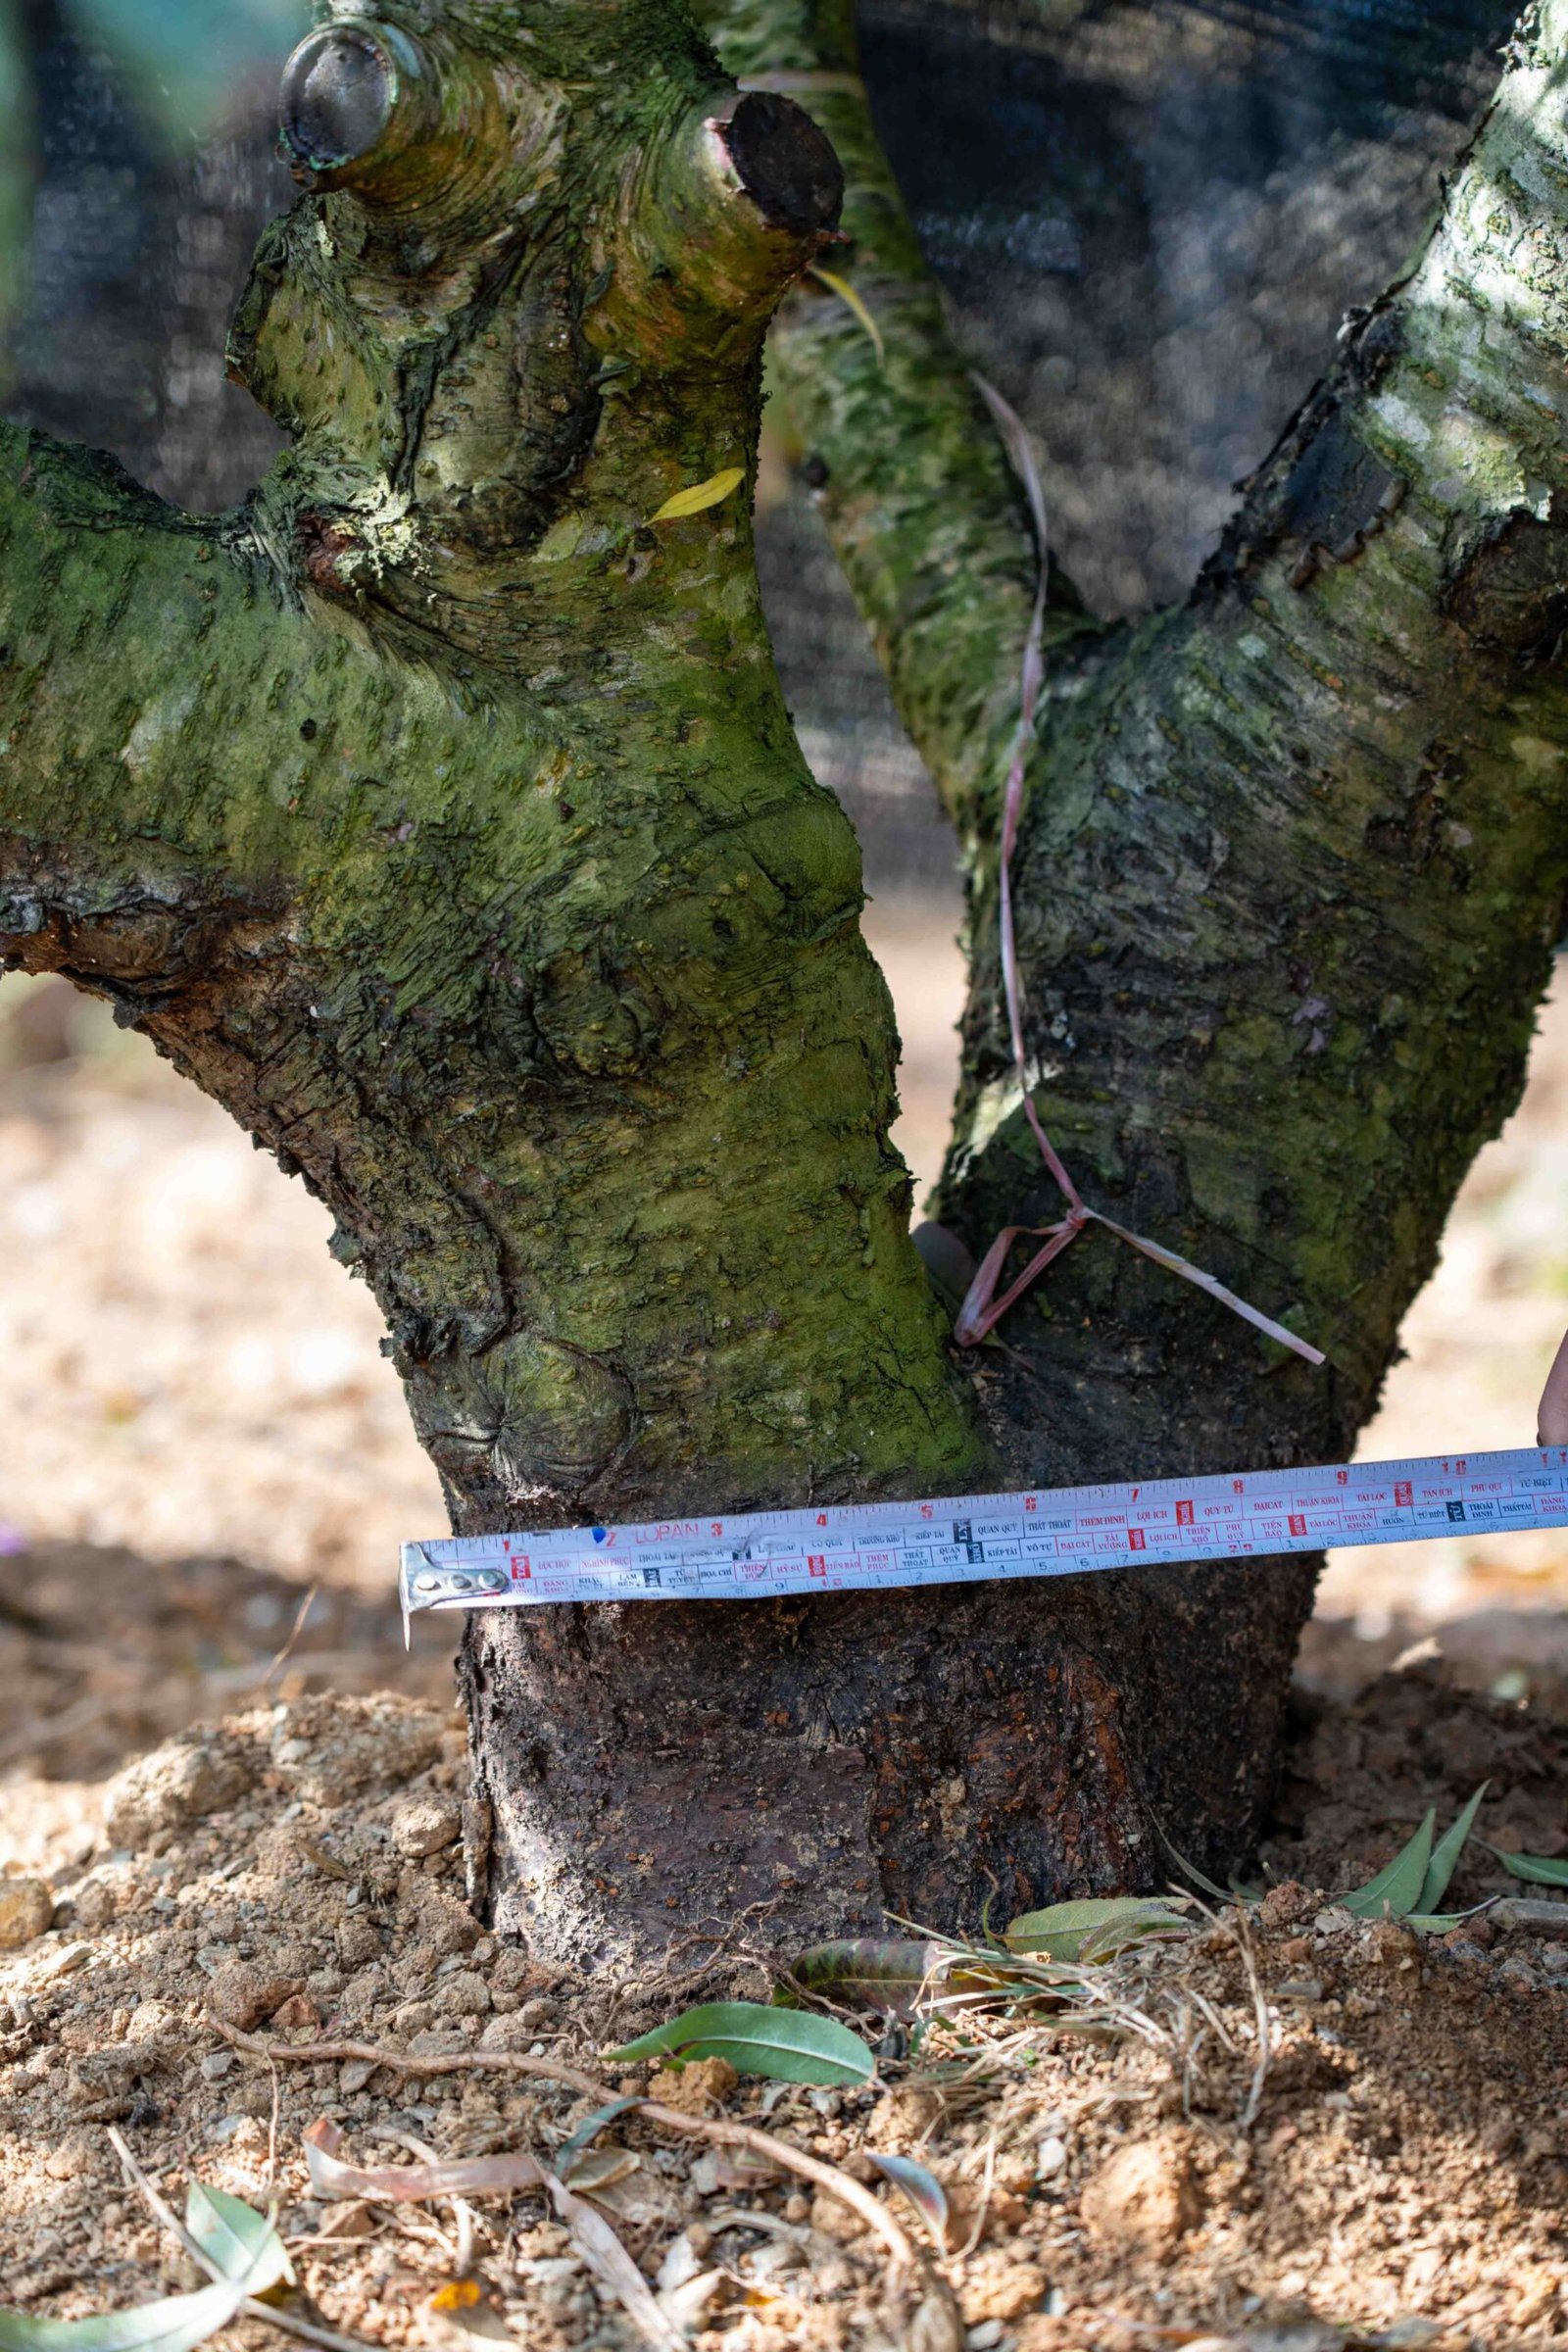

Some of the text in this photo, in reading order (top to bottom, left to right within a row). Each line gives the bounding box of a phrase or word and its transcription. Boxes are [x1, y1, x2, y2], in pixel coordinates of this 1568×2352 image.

[1442, 1460, 1466, 1475] 10
[1337, 1471, 1348, 1486] 9
[1233, 1480, 1244, 1494] 8
[1131, 1489, 1141, 1503] 7
[1025, 1496, 1037, 1512] 6
[921, 1505, 933, 1520] 5
[816, 1514, 828, 1527] 4
[711, 1523, 723, 1538] 3
[977, 1524, 999, 1535] QUAN
[607, 1532, 617, 1547] 2
[939, 1544, 960, 1554] QUAN
[1038, 1560, 1048, 1570] 5
[1079, 1556, 1090, 1567] 6
[1120, 1553, 1129, 1563] 7
